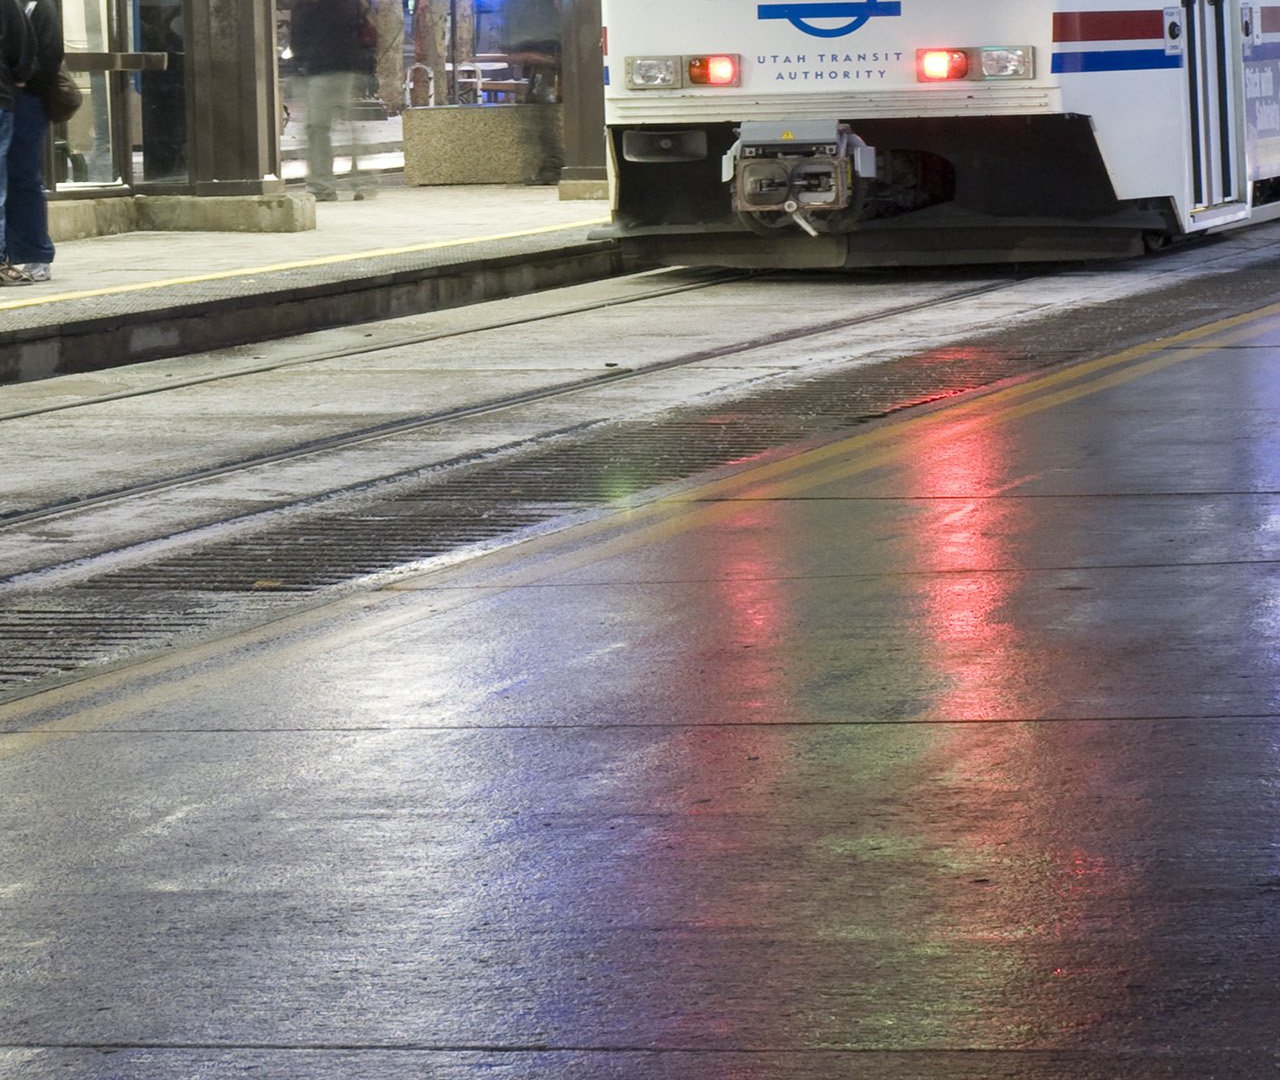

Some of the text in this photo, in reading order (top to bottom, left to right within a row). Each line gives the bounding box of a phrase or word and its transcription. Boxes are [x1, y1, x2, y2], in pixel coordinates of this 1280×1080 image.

[757, 52, 903, 64] UTAH TRANSIT
[776, 70, 887, 81] AUTHORITY
